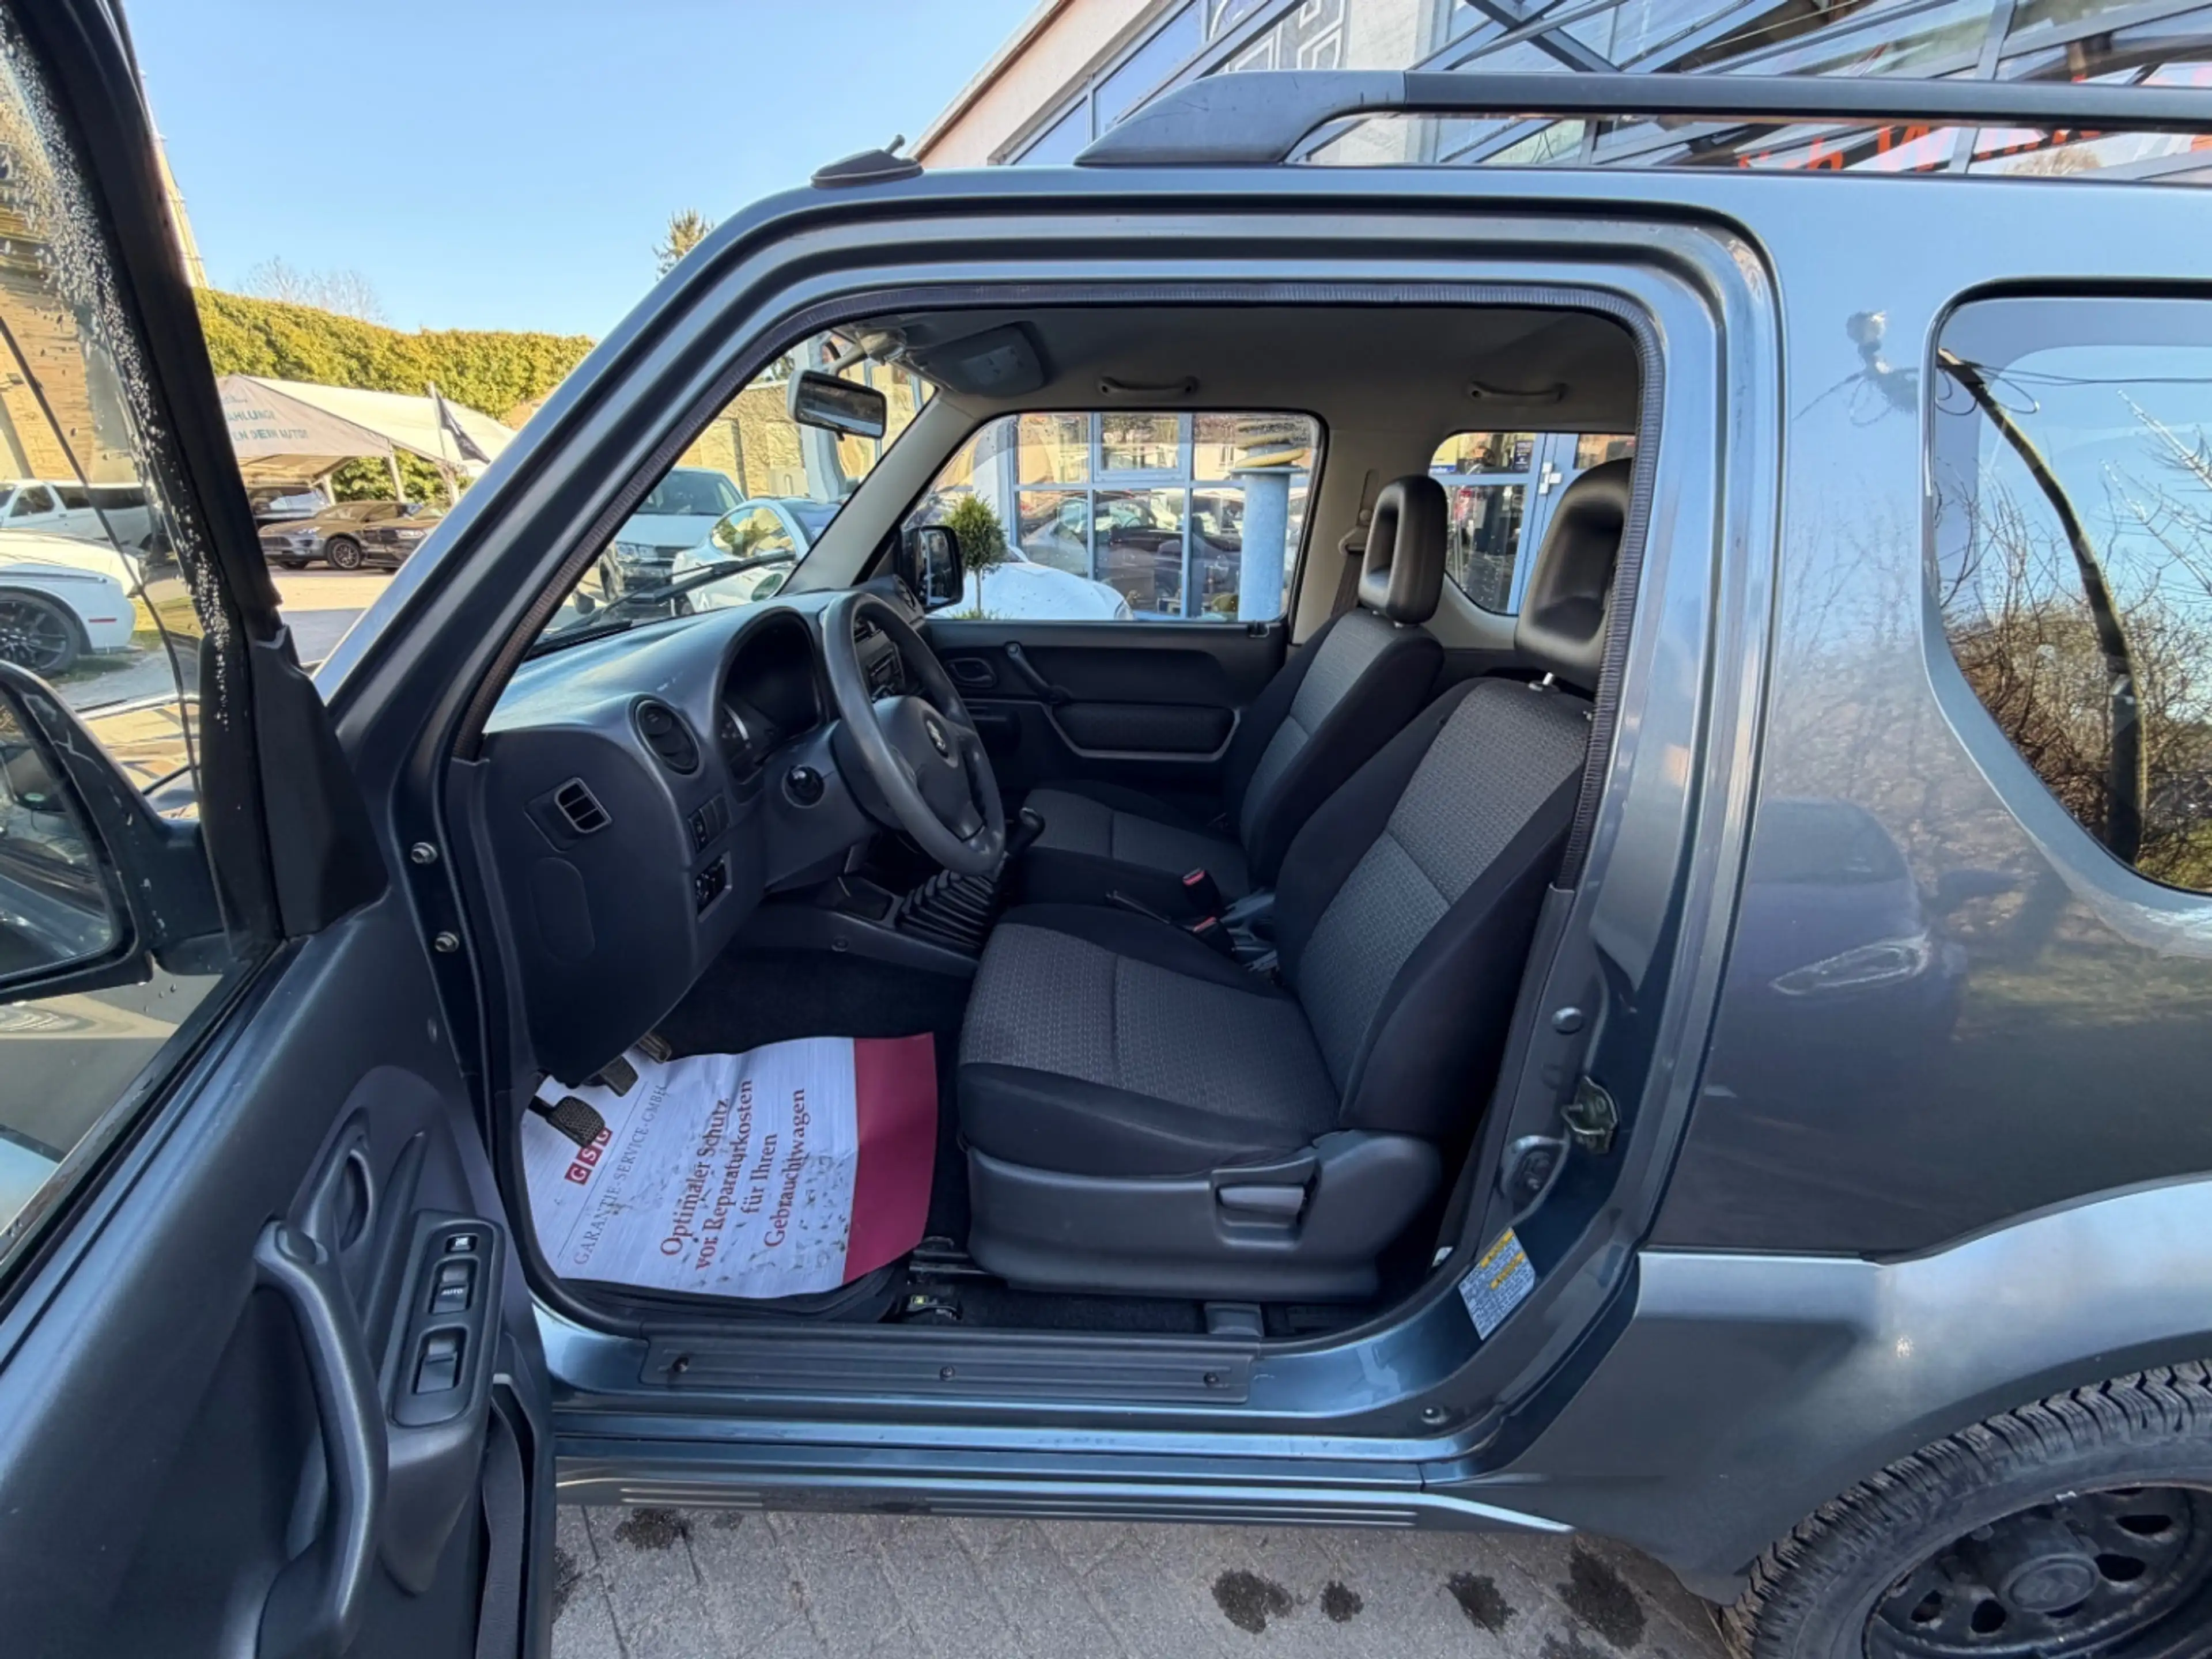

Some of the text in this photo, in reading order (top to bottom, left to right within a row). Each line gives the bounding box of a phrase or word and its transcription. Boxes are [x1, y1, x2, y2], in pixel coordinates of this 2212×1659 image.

[660, 1098, 728, 1256] Optimaler Schutz
[695, 1080, 753, 1271] vor Reparaturkosten
[740, 1133, 777, 1214] für Ihren
[763, 1088, 811, 1248] Gebrauchtwagen
